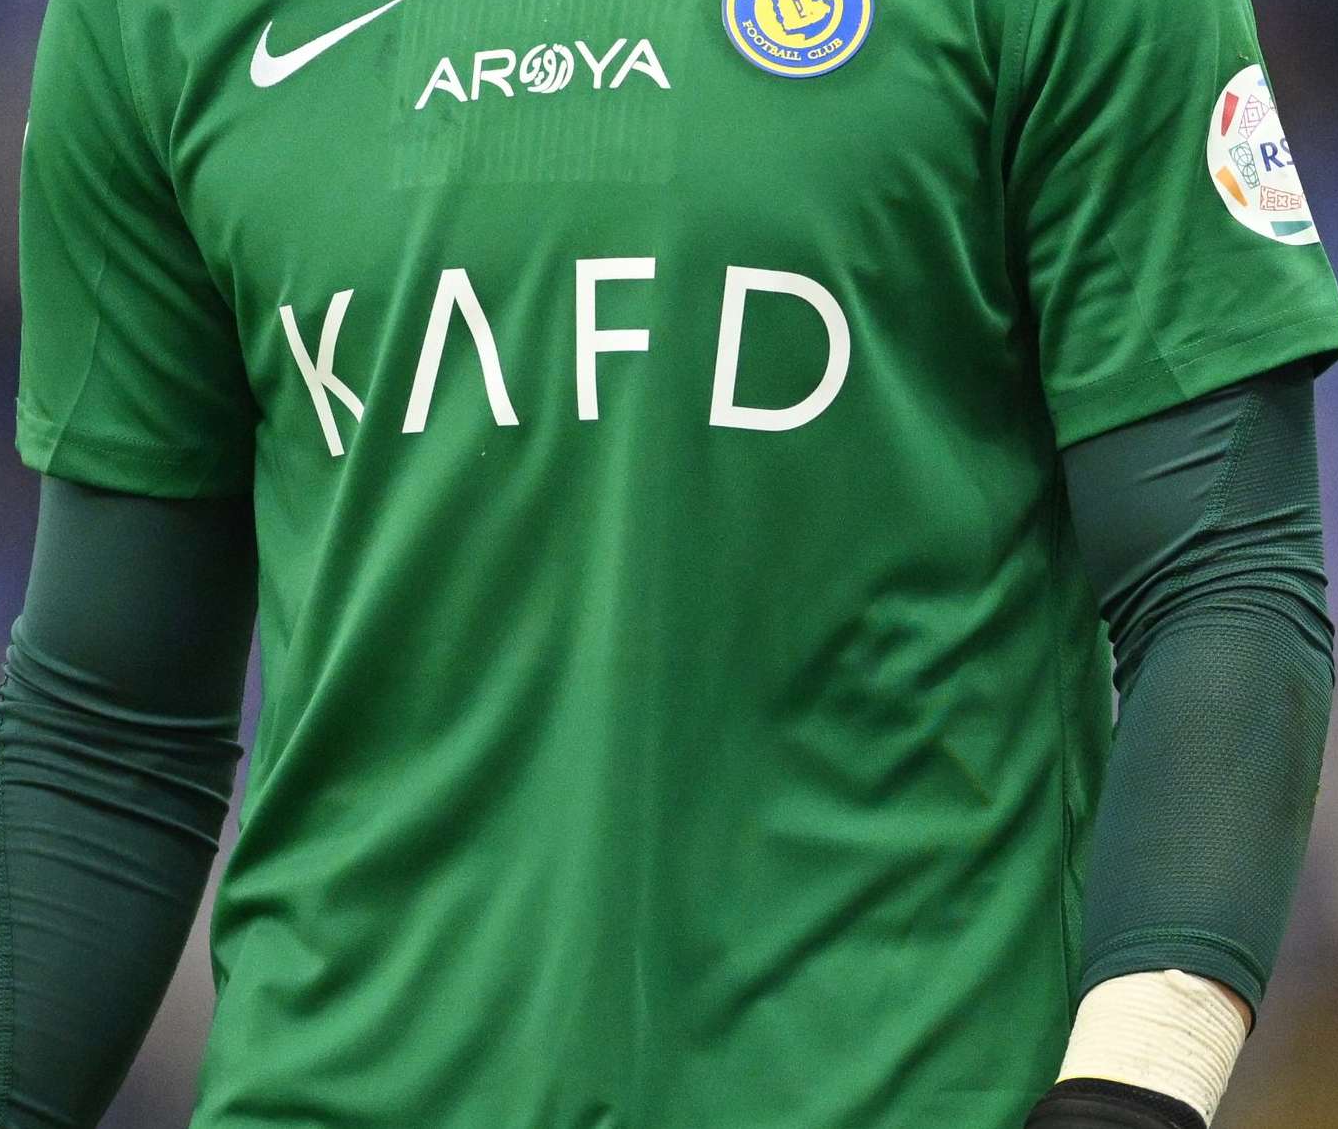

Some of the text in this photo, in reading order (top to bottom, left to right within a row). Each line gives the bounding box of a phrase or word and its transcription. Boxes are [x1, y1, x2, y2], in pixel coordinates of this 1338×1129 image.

[414, 38, 672, 110] AROYA
[742, 19, 844, 61] FOOTBALL CLUB
[279, 256, 851, 457] KAFD
